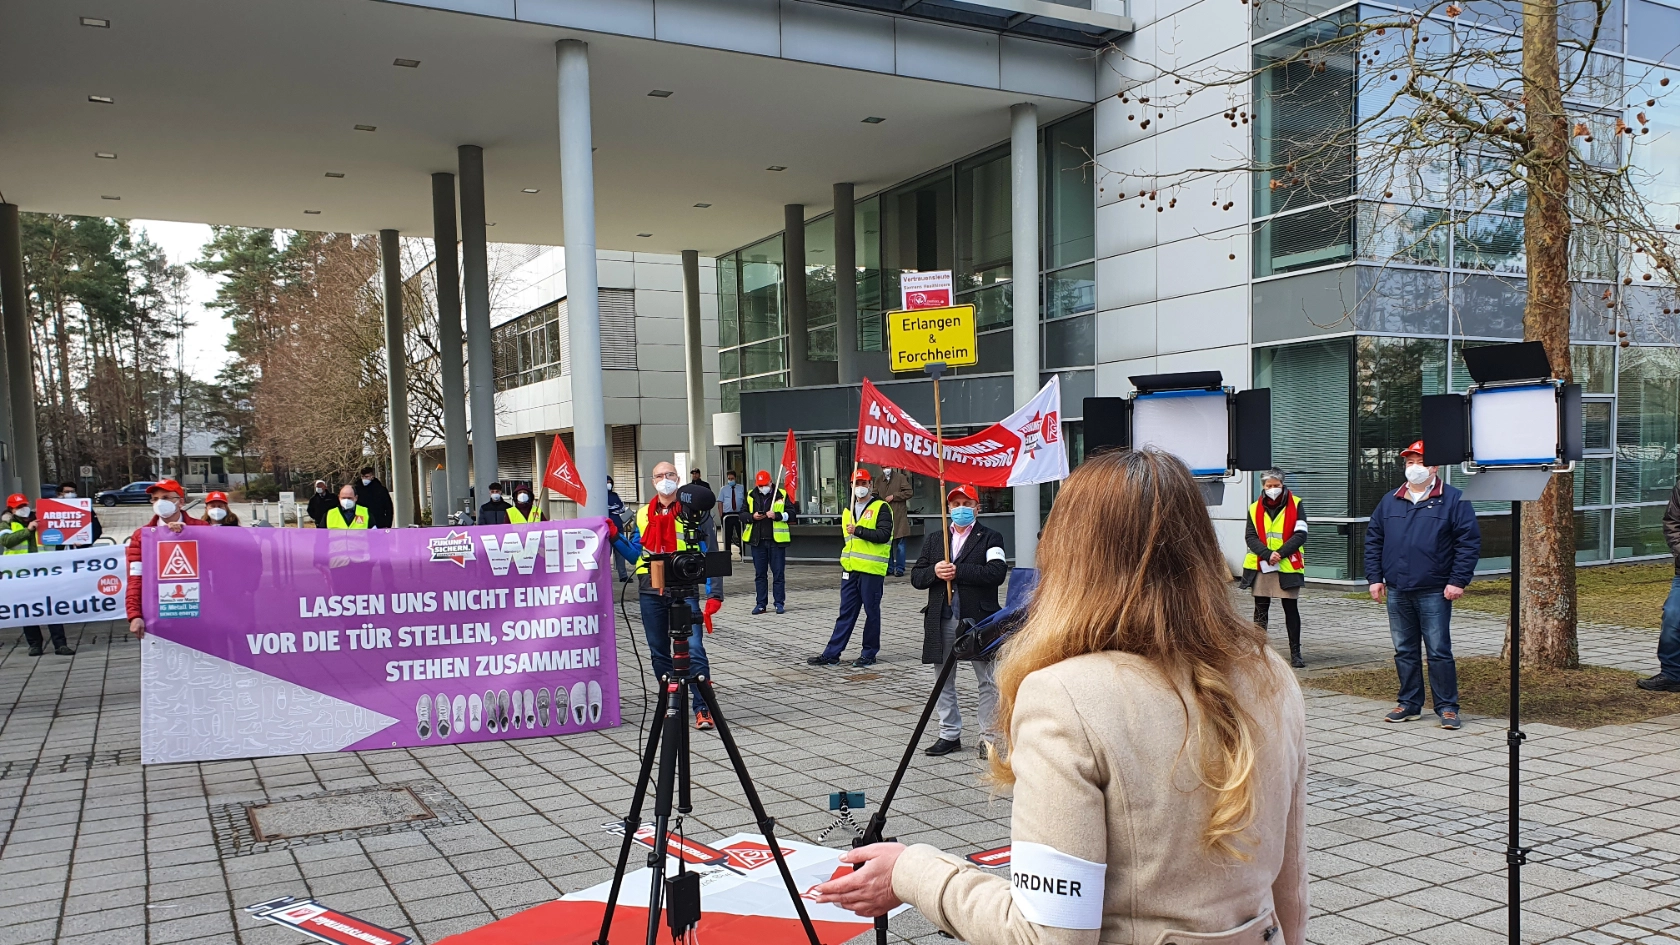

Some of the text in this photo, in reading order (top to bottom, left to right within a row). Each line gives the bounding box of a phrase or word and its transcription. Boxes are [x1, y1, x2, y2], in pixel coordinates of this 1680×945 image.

[902, 316, 961, 332] Erlangen
[928, 334, 937, 343] &
[898, 346, 968, 363] Forchheim
[864, 425, 901, 448] UND
[43, 511, 85, 520] ARBEITS-
[48, 518, 82, 529] PLÄTZE
[433, 538, 468, 546] ZUKUNFT
[434, 545, 471, 553] SICHERN.
[480, 528, 599, 576] WIR
[72, 557, 118, 573] F80
[0, 595, 116, 620] ensleute
[299, 582, 598, 618] LASSEN UNS NICHT EINFACH
[246, 614, 600, 655] VOR DIE TÜR STELLEN, SONDERN
[385, 647, 601, 682] STEHEN ZUSAMMEN!
[1013, 872, 1082, 897] ORDNER
